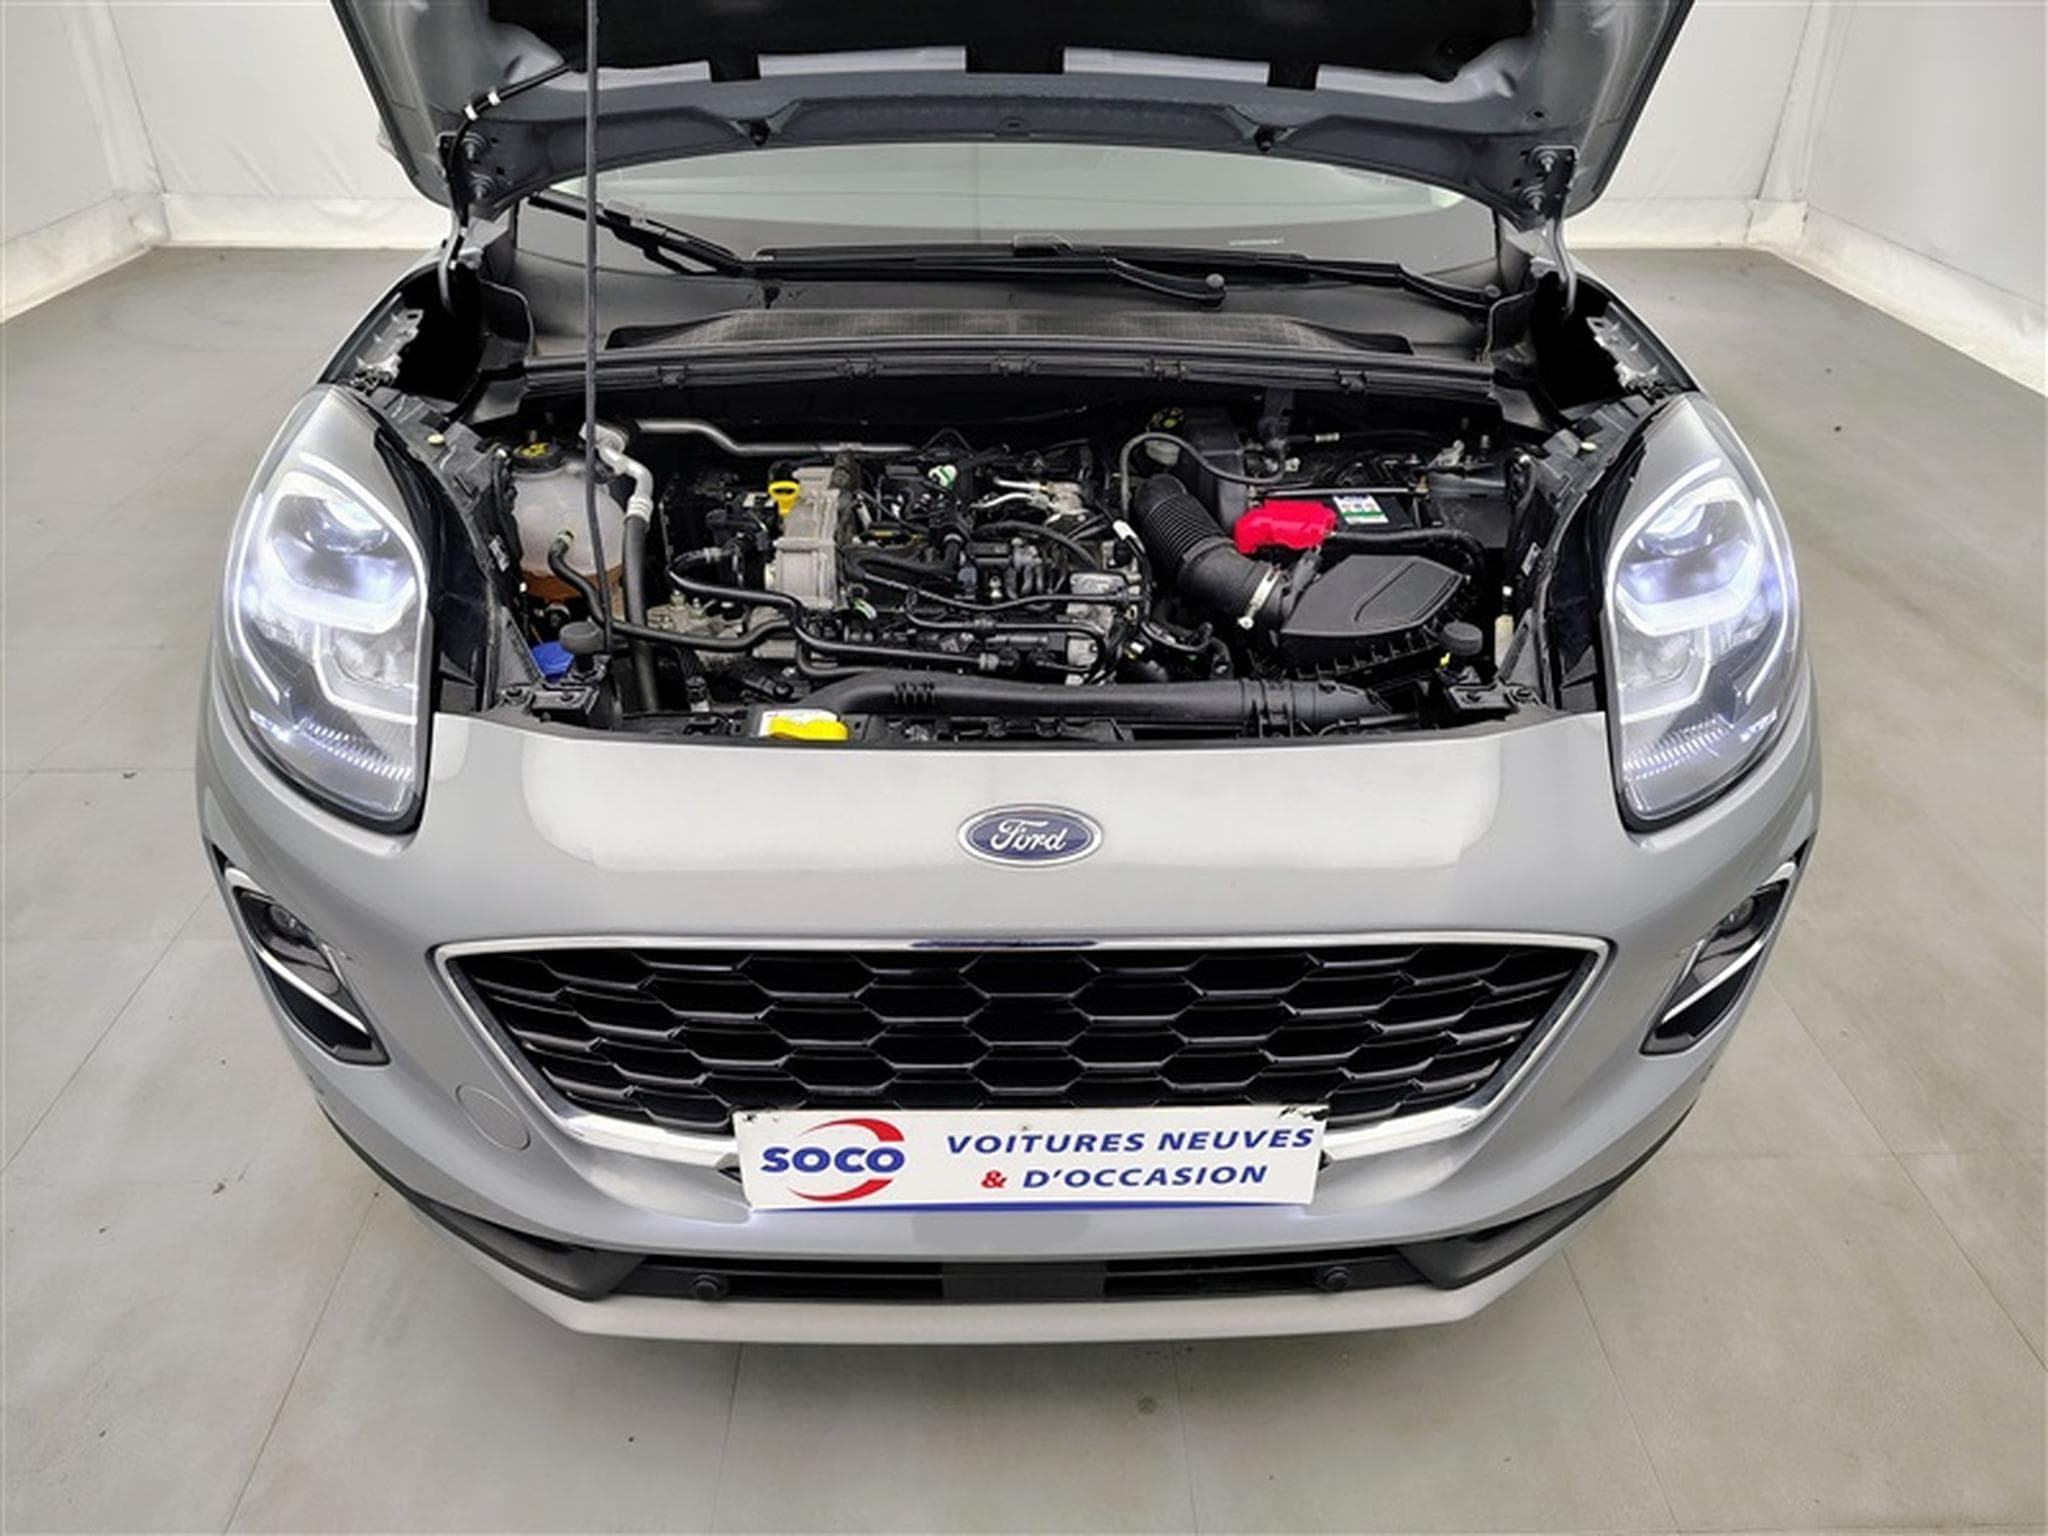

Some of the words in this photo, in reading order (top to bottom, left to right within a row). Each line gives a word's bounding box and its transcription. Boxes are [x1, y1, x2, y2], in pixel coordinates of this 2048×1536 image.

[990, 818, 1068, 851] Ford
[947, 1132, 1145, 1154] VOITURES
[1157, 1128, 1314, 1151] NEUVES
[760, 1146, 905, 1173] SOCO
[981, 1169, 1007, 1189] &
[1022, 1165, 1268, 1188] D'OCCASION
